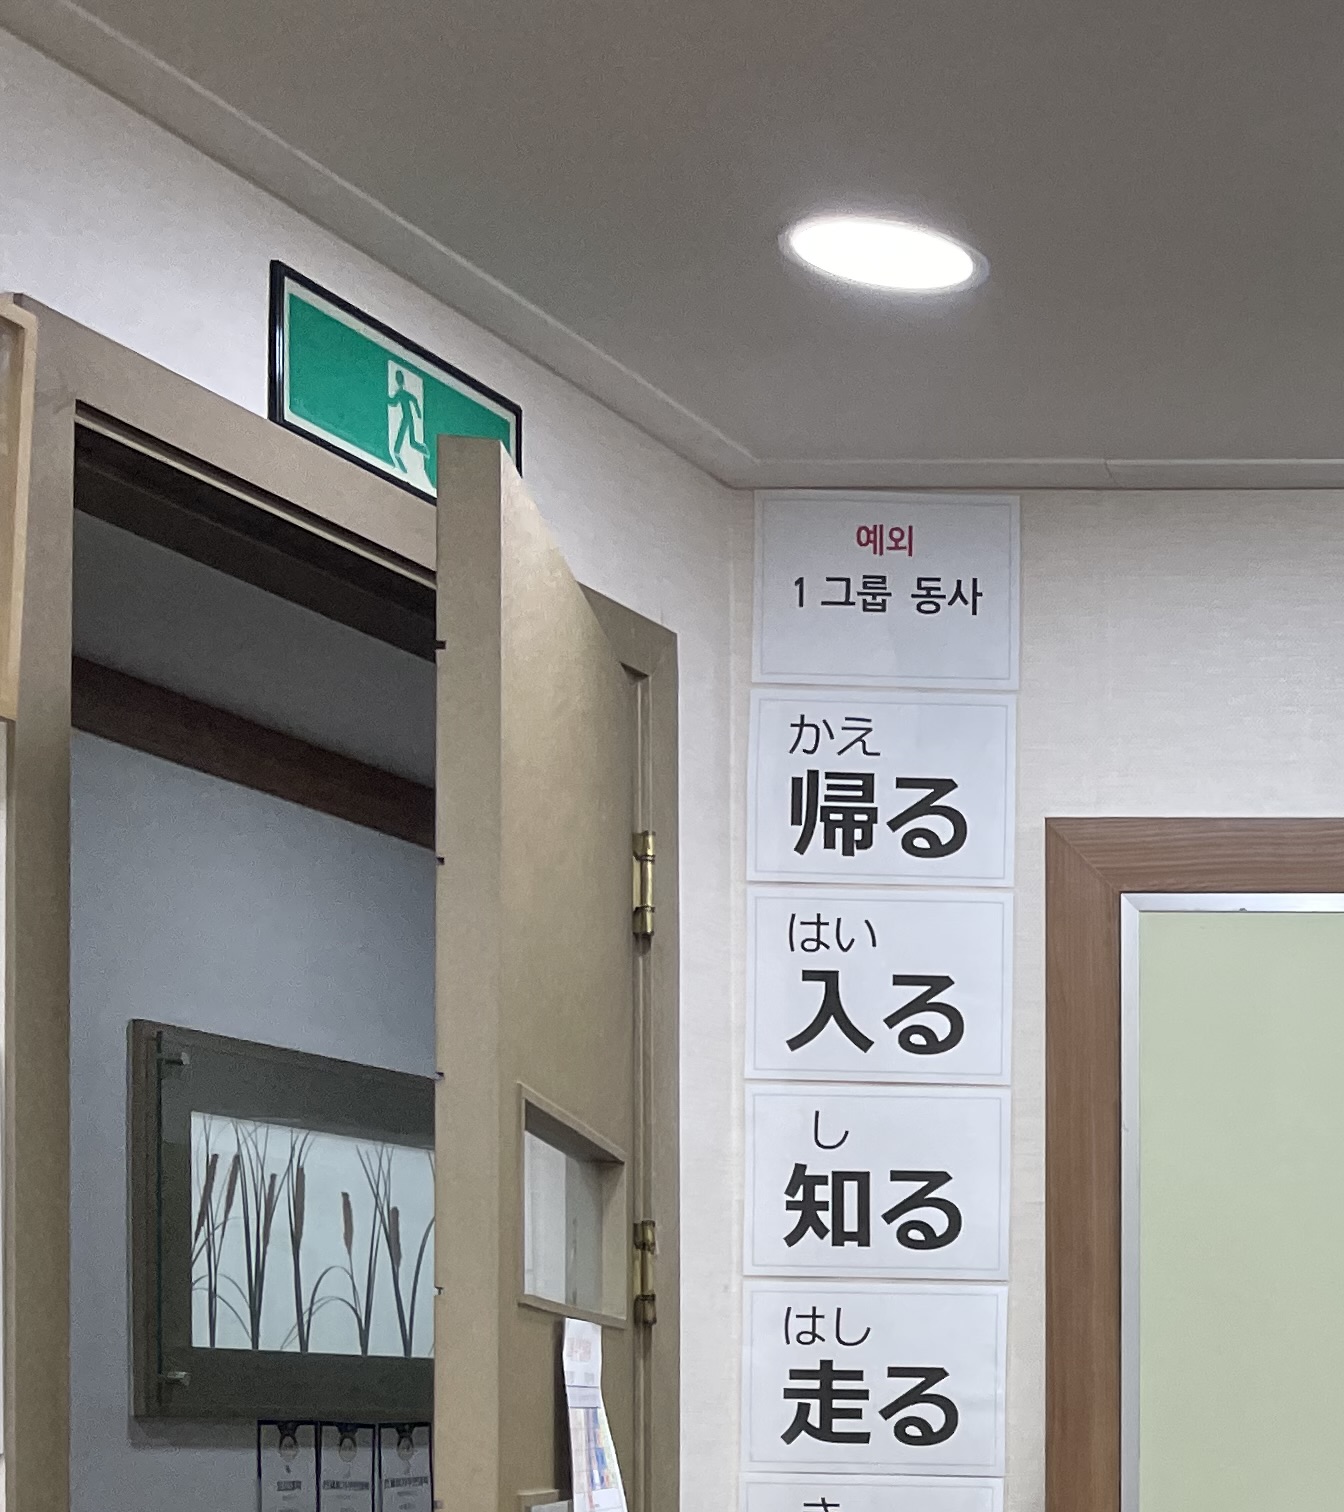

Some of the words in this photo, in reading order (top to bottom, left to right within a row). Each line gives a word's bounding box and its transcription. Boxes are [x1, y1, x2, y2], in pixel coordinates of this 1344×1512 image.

[856, 523, 914, 558] 예외
[910, 576, 983, 616] 동사
[788, 714, 881, 757] かえ
[790, 769, 968, 860] 帰る
[787, 912, 878, 953] はい
[785, 969, 966, 1056] 入る
[813, 1110, 849, 1150] し
[783, 1162, 963, 1251] 知る
[784, 1306, 871, 1347] はし
[780, 1359, 960, 1447] 走る
